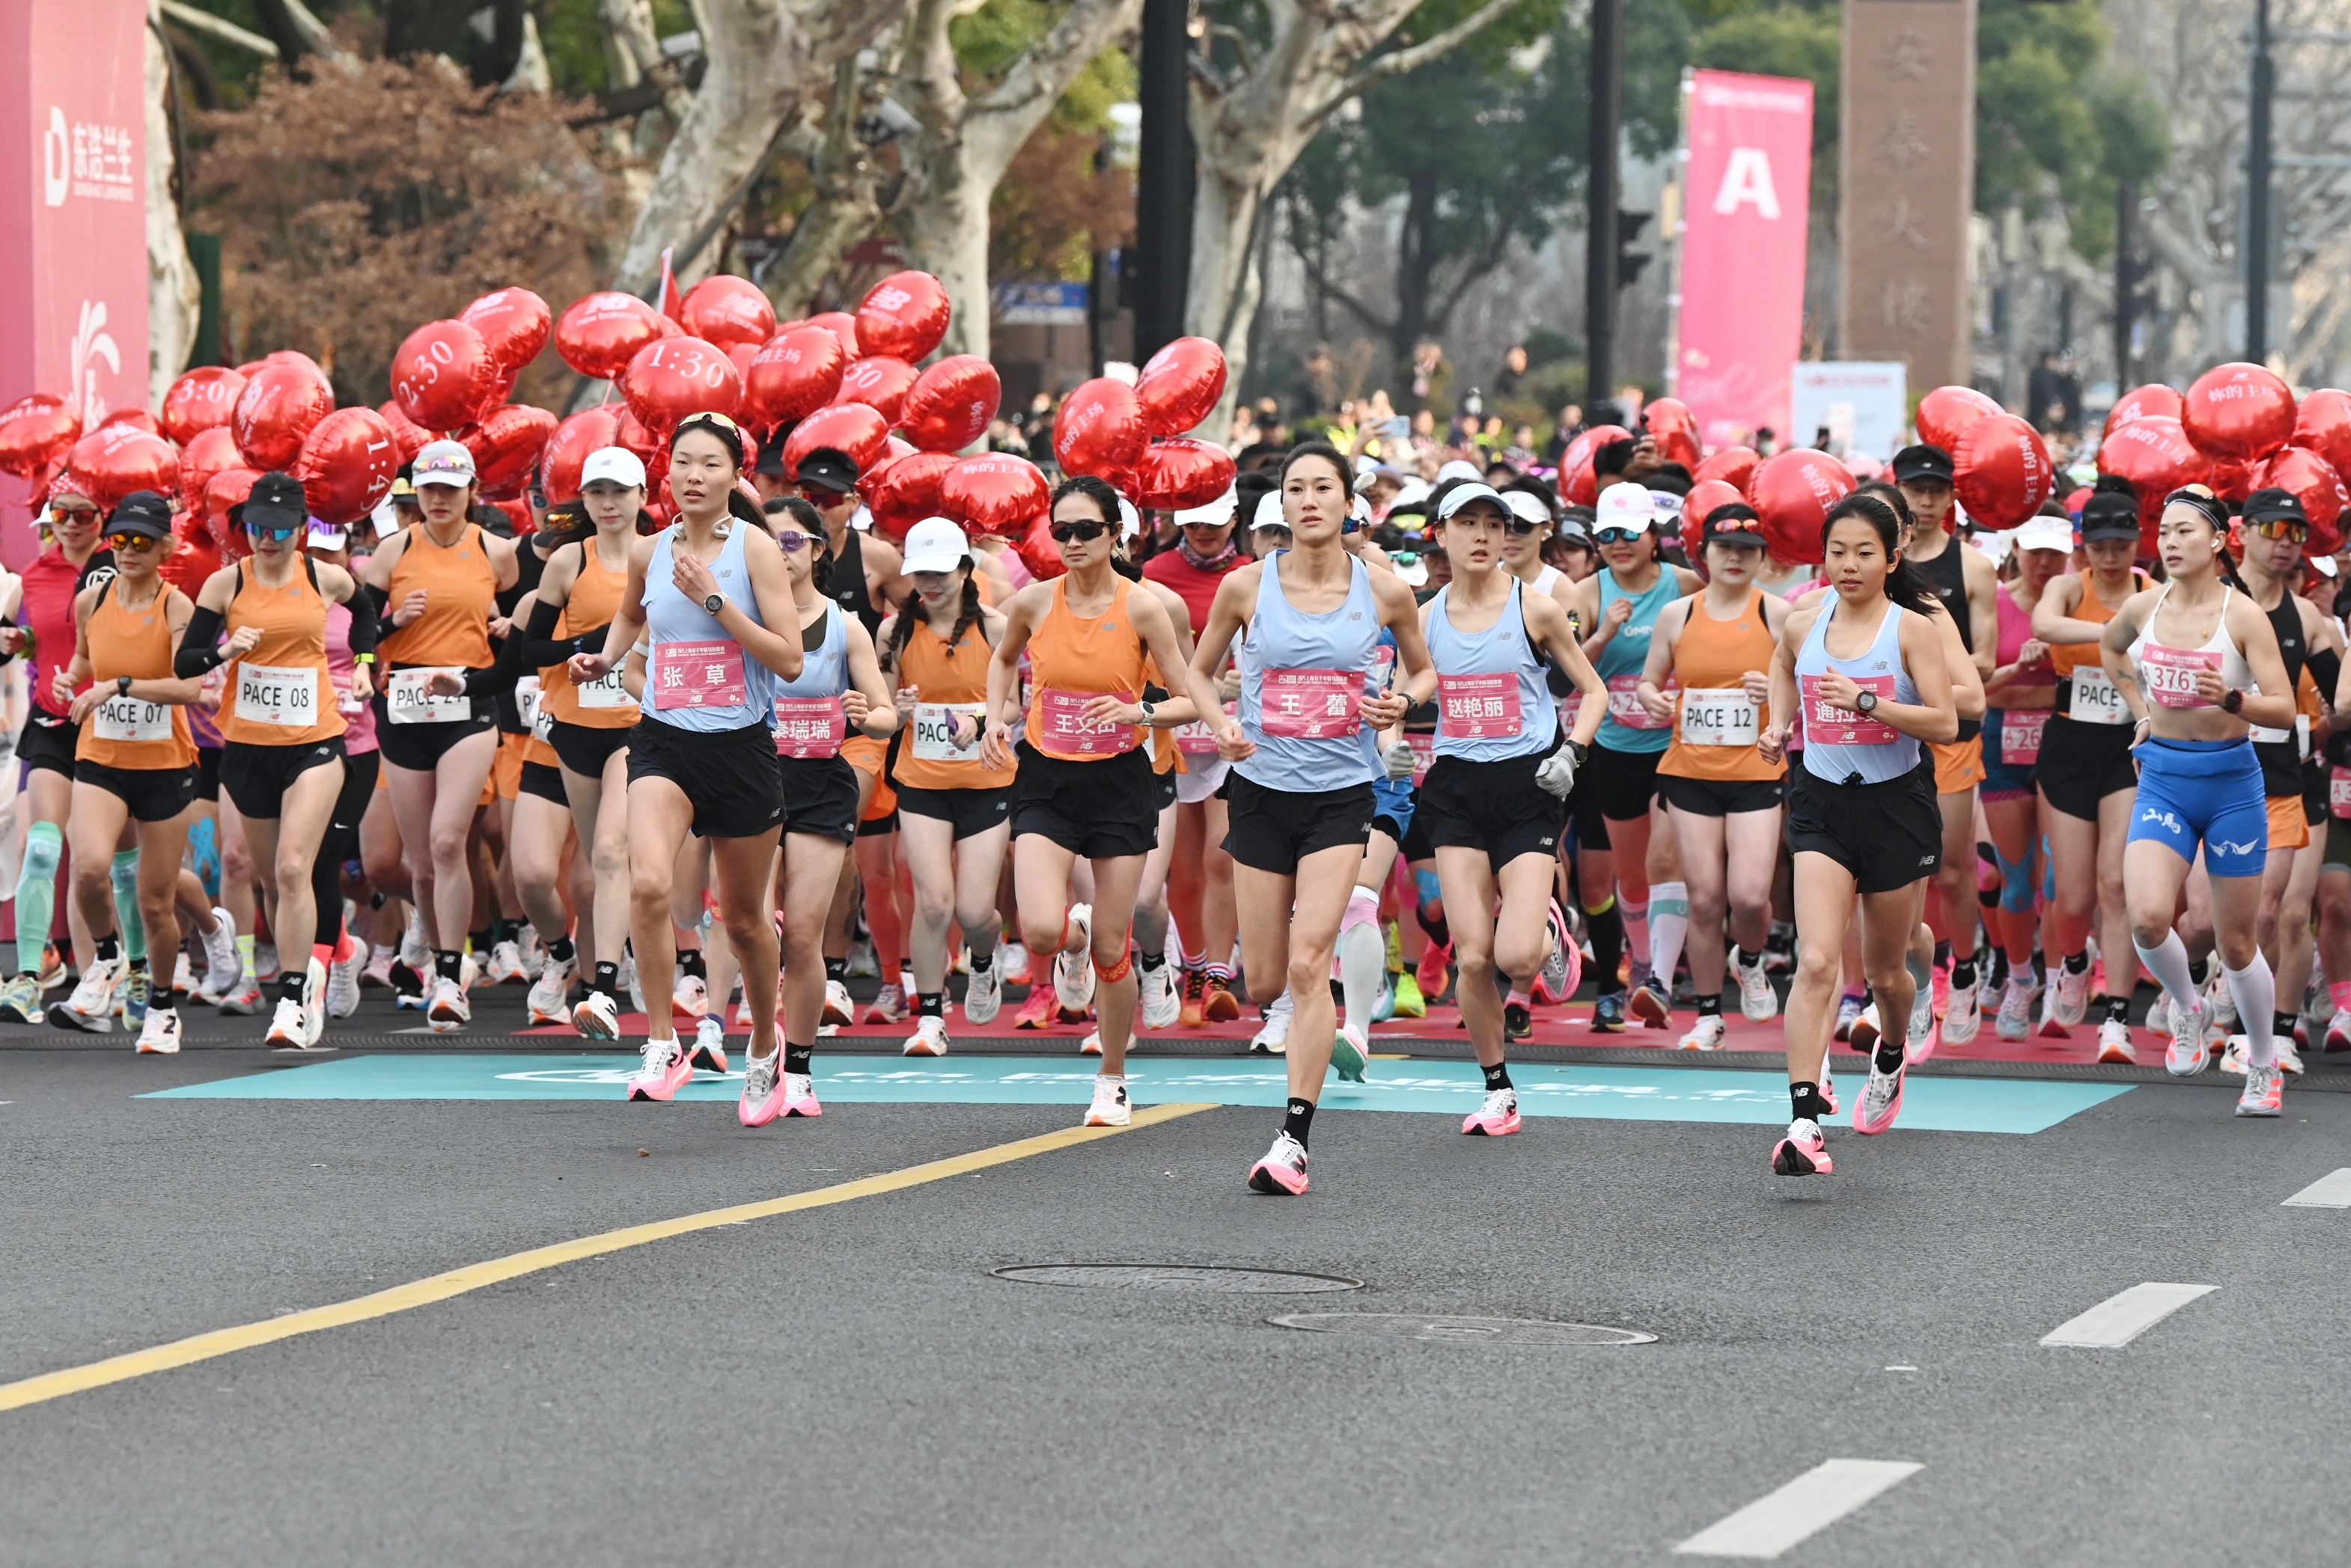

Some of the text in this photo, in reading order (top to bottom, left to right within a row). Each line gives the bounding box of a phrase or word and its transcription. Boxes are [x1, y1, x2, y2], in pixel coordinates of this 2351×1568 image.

[73, 122, 132, 183] 东浩兰生
[1713, 148, 1780, 219] A
[584, 295, 631, 315] NB
[576, 310, 642, 326] new balance
[648, 344, 725, 388] 1:30
[398, 341, 454, 407] 2:30
[360, 436, 391, 513] 1:45
[716, 570, 732, 579] NB
[1346, 611, 1362, 621] NB
[1100, 623, 1116, 631] NB
[1495, 632, 1513, 641] NB
[825, 652, 838, 662] NB
[1870, 661, 1888, 671] NB
[663, 664, 727, 688] 张 草
[2154, 667, 2197, 691] 376
[243, 682, 308, 707] PACE 08
[689, 695, 703, 704] NB
[2079, 685, 2120, 707] PACE
[1280, 694, 1347, 716] 王 蕾
[1447, 696, 1504, 718] 赵艳丽
[99, 704, 164, 724] PACE 07
[1686, 707, 1751, 727] PACE 12
[918, 722, 949, 742] PAC
[1305, 724, 1321, 733] NB
[1469, 725, 1482, 733] NB
[1840, 731, 1856, 740] NB
[1079, 742, 1094, 750] NB
[1360, 822, 1372, 833] NB
[1539, 836, 1554, 846] NB
[1918, 854, 1936, 867] NB
[597, 964, 614, 974] NB
[285, 976, 302, 986] NB
[922, 998, 937, 1007] NB
[790, 1049, 810, 1059] NB
[1486, 1069, 1501, 1081] NB
[1793, 1085, 1813, 1099] NB
[1287, 1103, 1305, 1115] NB
